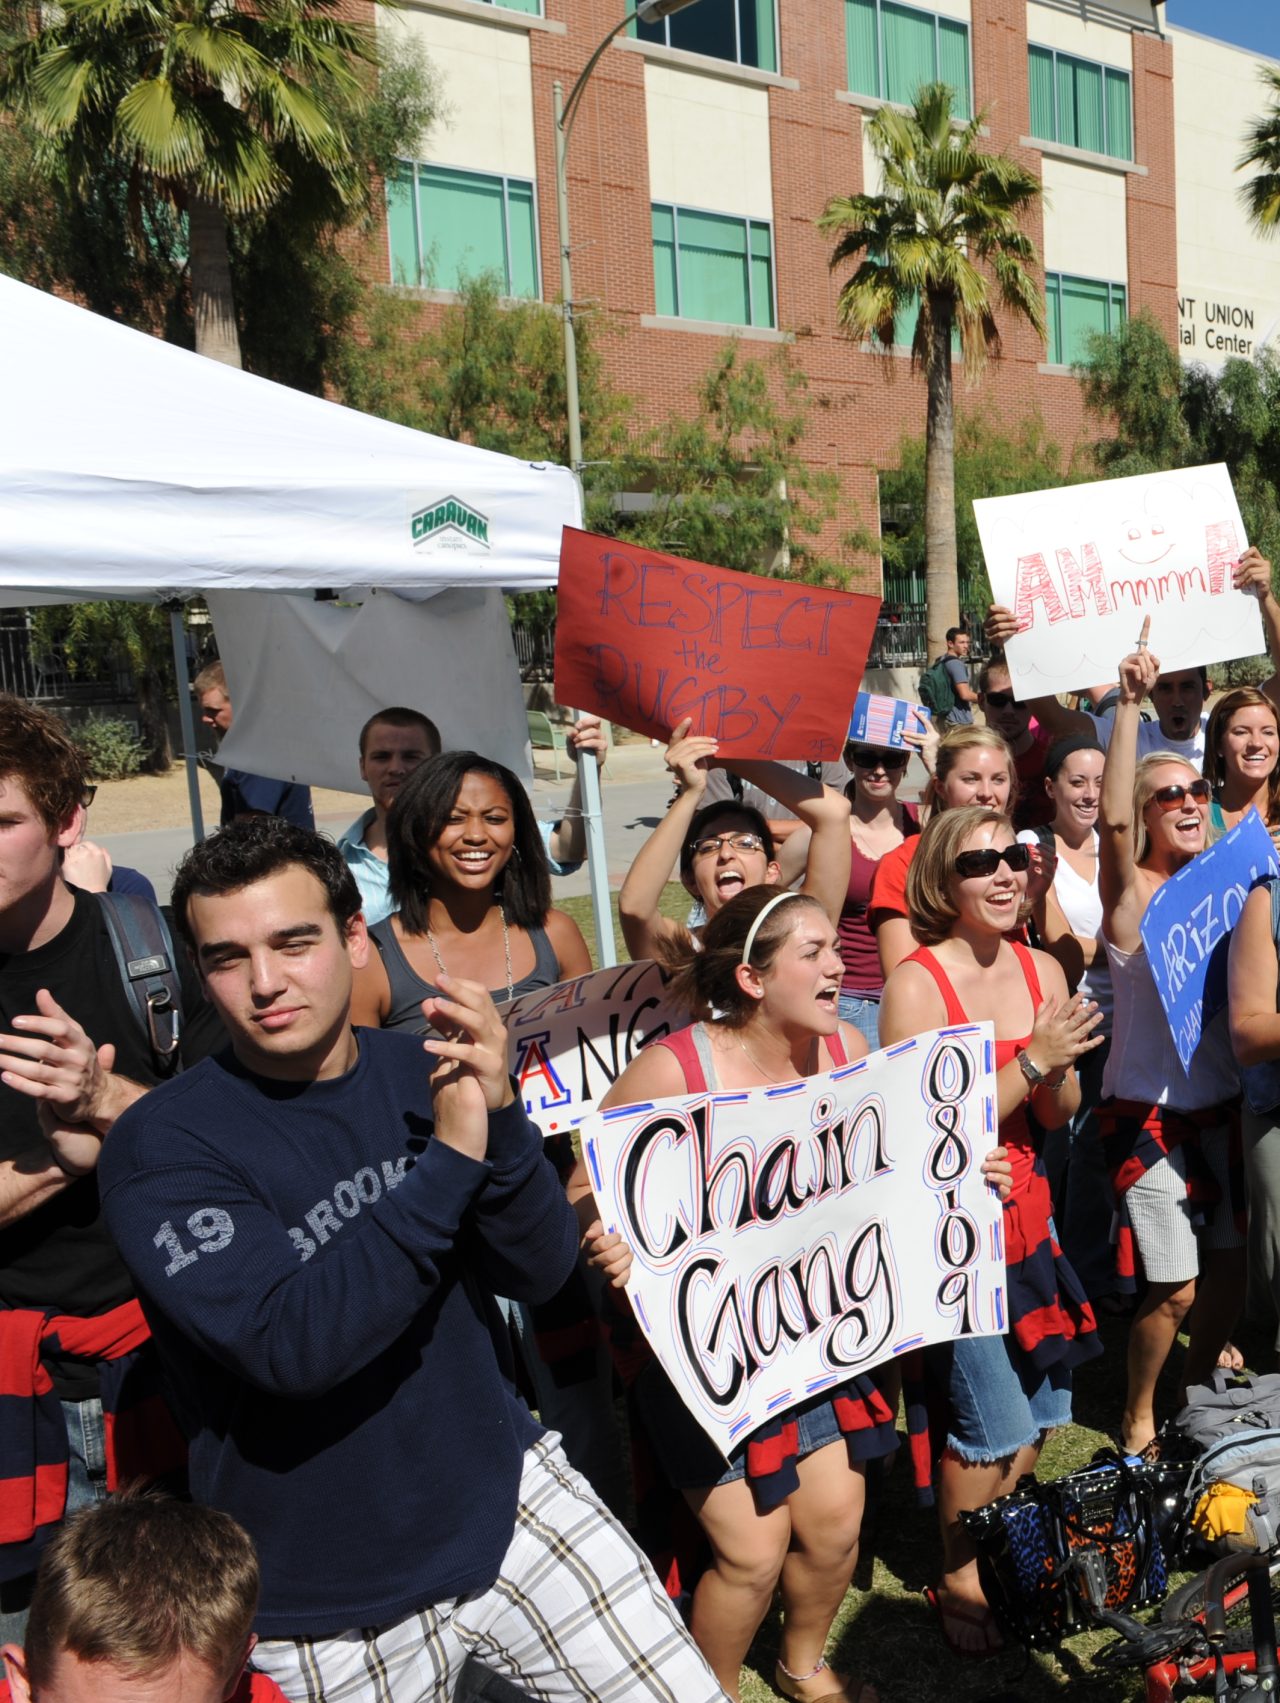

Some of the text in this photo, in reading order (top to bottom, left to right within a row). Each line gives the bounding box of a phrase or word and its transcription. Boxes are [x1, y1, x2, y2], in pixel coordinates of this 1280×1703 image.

[1205, 302, 1254, 330] UNION
[1205, 329, 1252, 354] Center
[411, 500, 489, 543] CARAVAN
[596, 552, 853, 656] RESPECT
[585, 643, 801, 755] RUGBY
[674, 639, 727, 674] the
[287, 1155, 418, 1262] BROOK
[620, 1098, 893, 1268] Chain
[152, 1206, 236, 1278] 19
[674, 1217, 898, 1412] Gang
